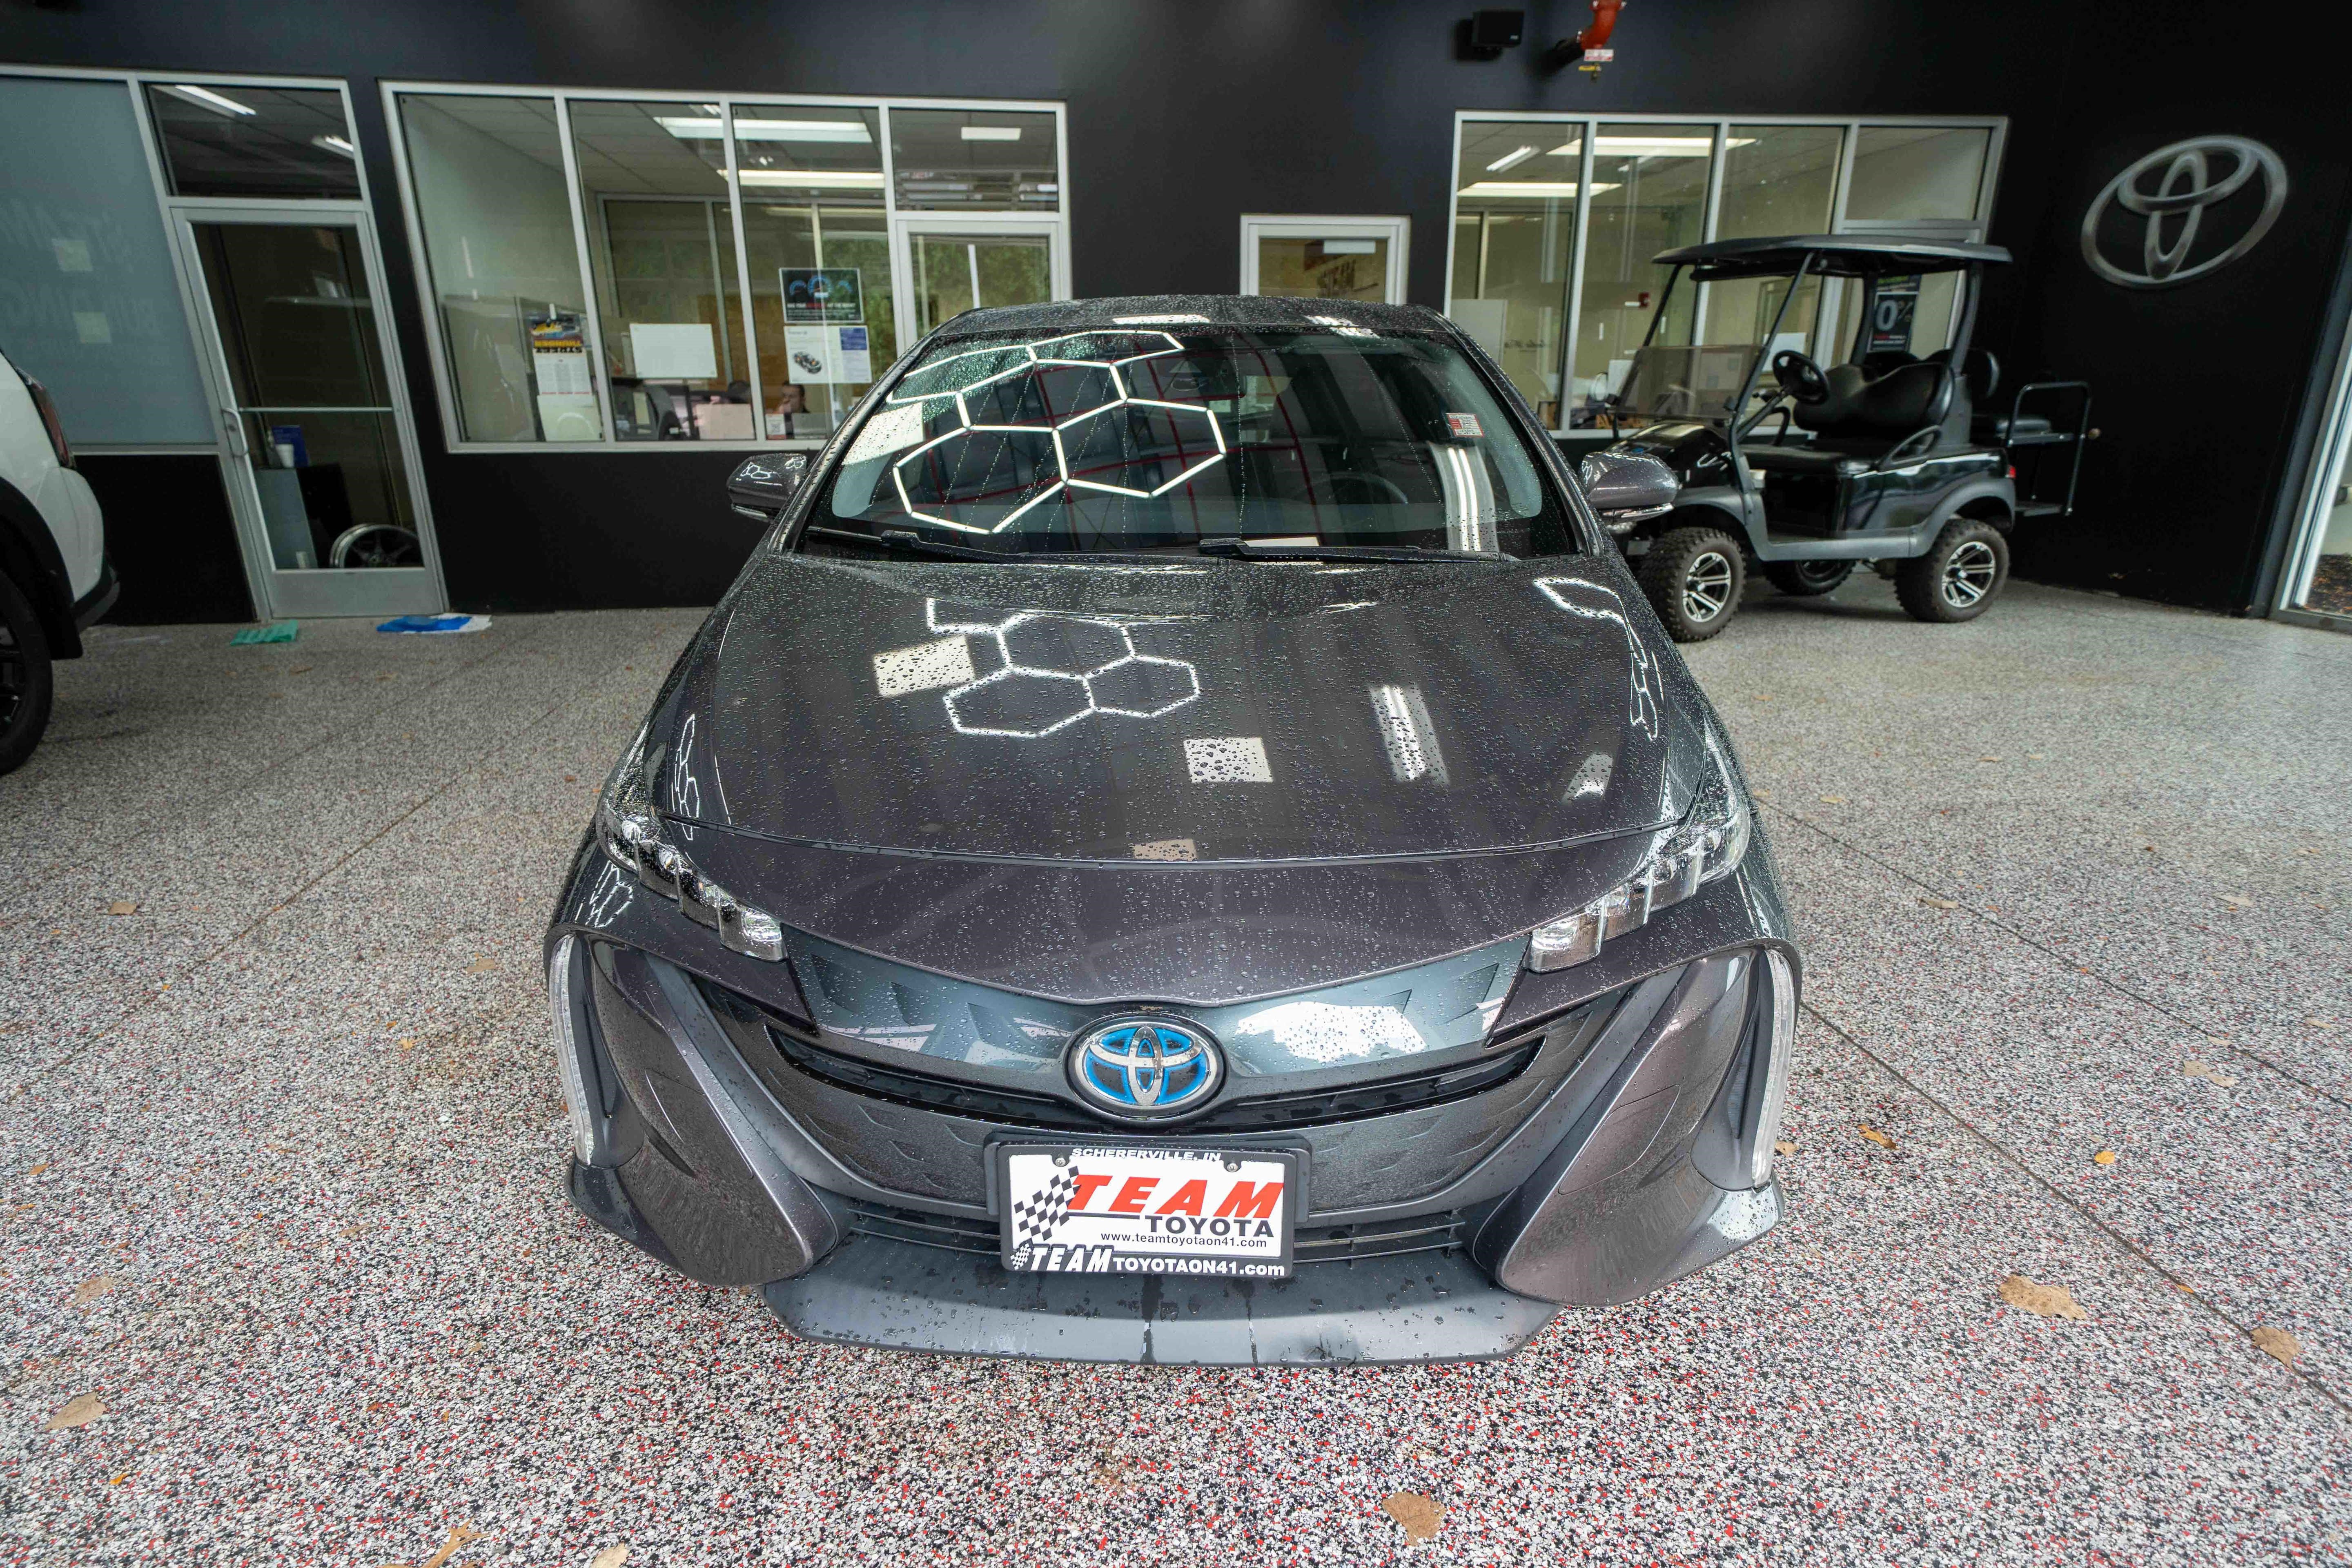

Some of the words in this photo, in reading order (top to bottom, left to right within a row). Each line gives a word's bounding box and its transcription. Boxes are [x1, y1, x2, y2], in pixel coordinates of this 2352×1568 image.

[1203, 1152, 1221, 1161] IN
[1067, 1174, 1284, 1218] TEAM
[1145, 1215, 1274, 1237] TOYOTA
[1101, 1233, 1267, 1247] www.teamtoyotaon41.com
[1030, 1248, 1112, 1272] TEAM
[1113, 1257, 1285, 1276] TOYOTAON41.com
